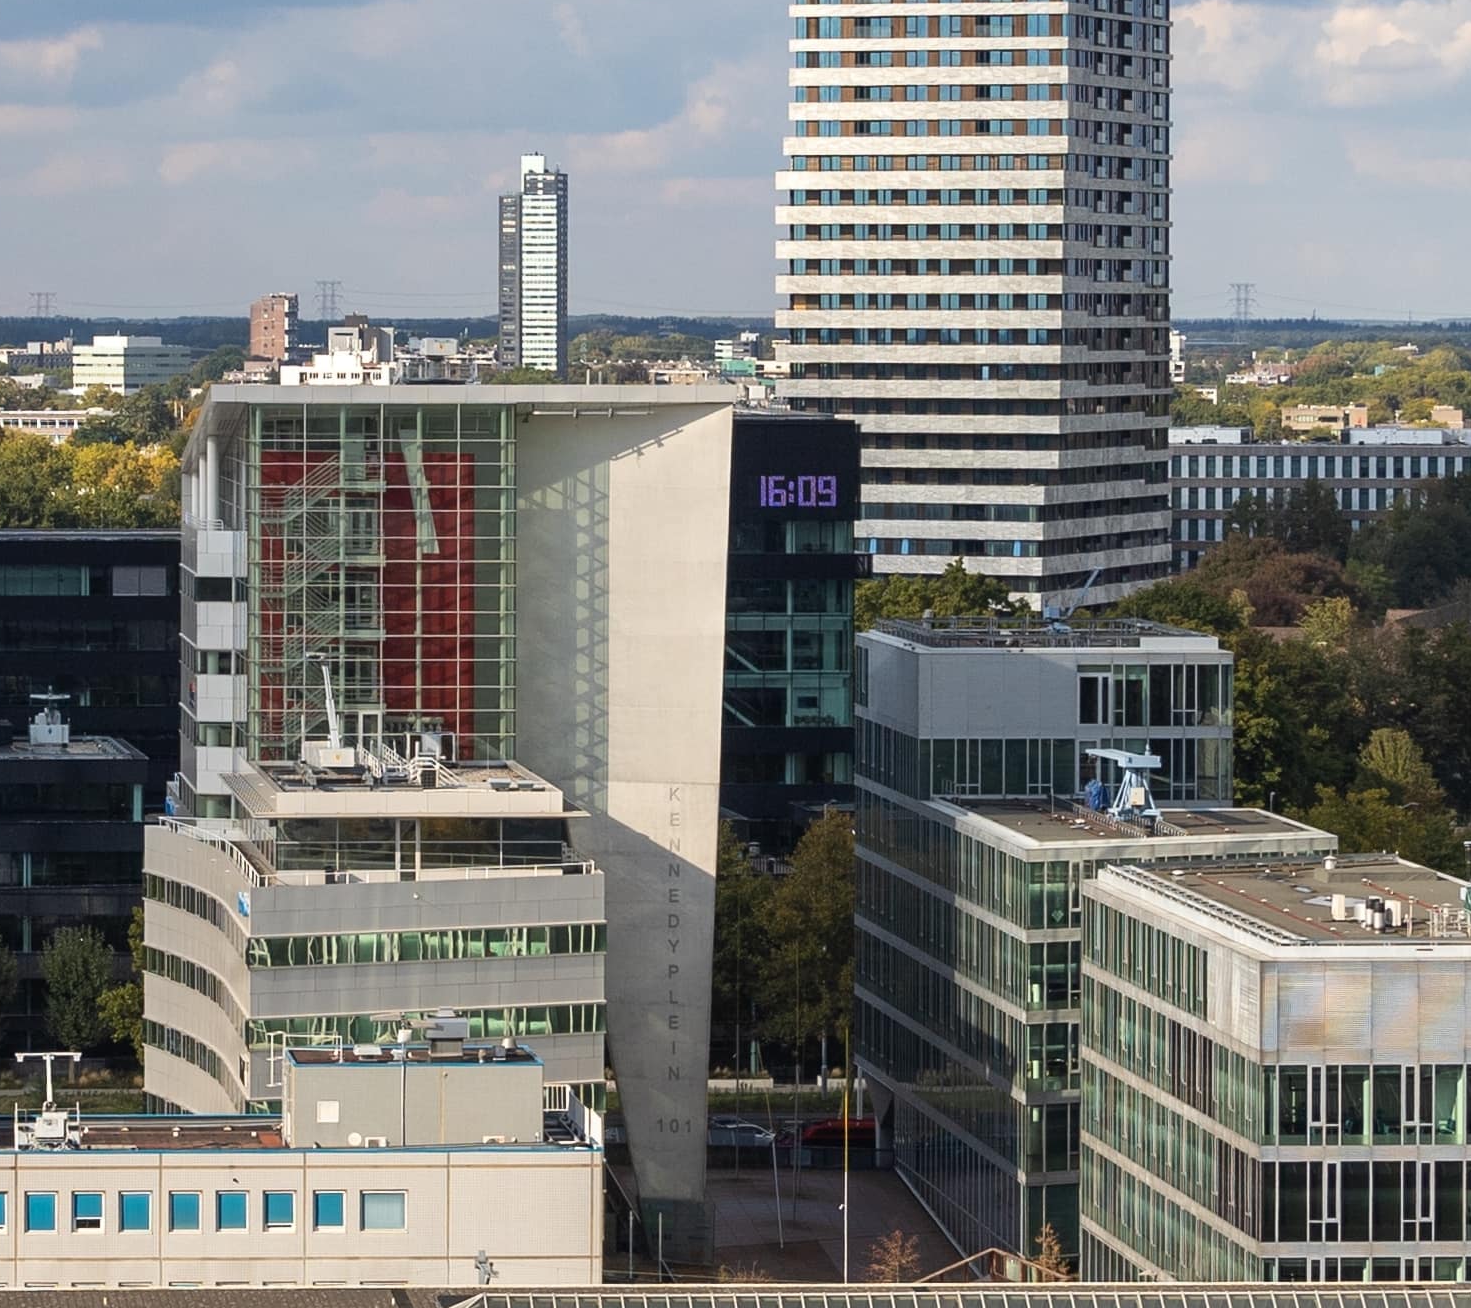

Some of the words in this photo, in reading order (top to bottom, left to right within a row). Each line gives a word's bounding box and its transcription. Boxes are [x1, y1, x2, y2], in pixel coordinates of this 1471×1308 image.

[760, 475, 837, 507] 16:09
[667, 786, 681, 1082] KENNEDYPLEIN
[656, 1118, 692, 1134] 101
